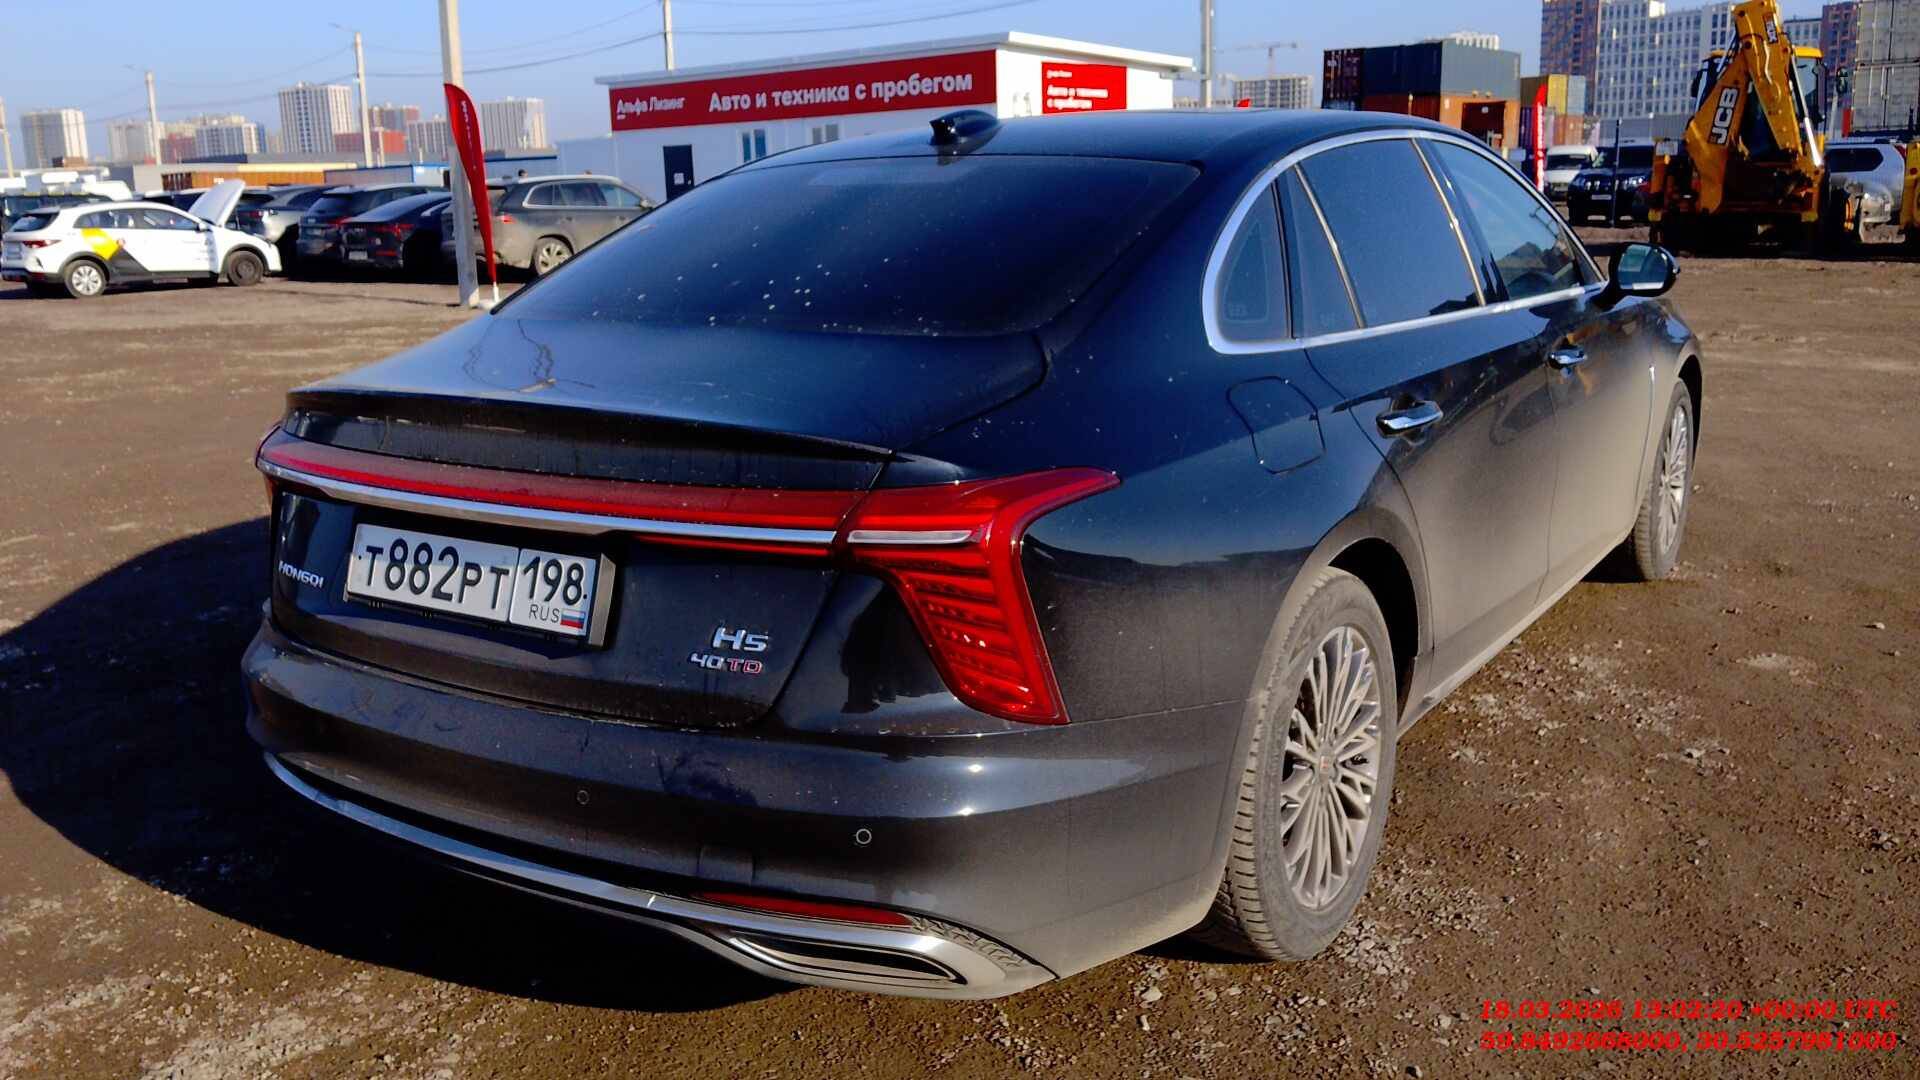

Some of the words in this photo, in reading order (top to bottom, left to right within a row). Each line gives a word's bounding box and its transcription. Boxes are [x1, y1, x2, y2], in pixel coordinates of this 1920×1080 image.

[616, 97, 648, 116] Альфа
[649, 96, 685, 111] Лизинг
[709, 92, 751, 113] Авто
[755, 93, 767, 109] и
[771, 84, 850, 107] техника
[854, 85, 867, 100] с
[871, 73, 973, 102] пробегом
[1711, 87, 1739, 145] JCB
[278, 560, 325, 588] HONGQI
[522, 555, 585, 606] 198
[528, 603, 560, 624] RUS
[712, 627, 769, 652] H5
[690, 652, 763, 675] 40TD
